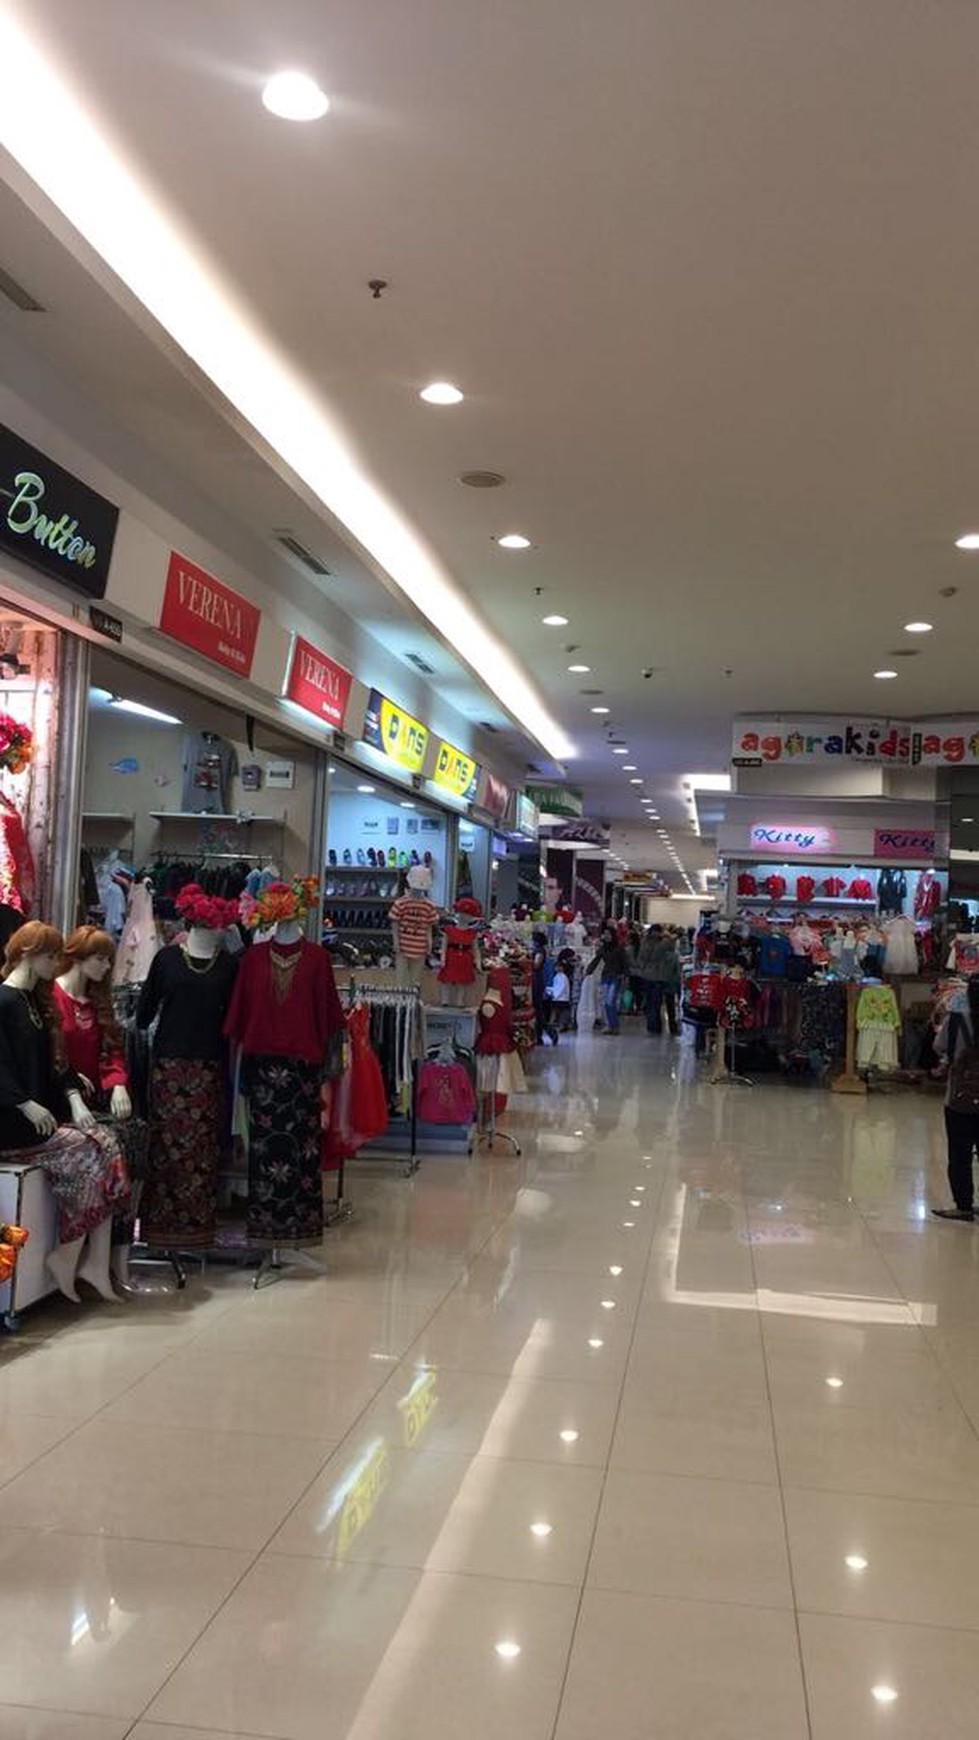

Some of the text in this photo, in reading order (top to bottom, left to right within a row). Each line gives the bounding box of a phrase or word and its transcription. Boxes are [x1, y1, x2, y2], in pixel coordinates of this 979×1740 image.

[7, 472, 96, 569] Button
[178, 571, 243, 640] VERENA
[299, 650, 340, 700] VERENA
[754, 828, 816, 848] Kitty
